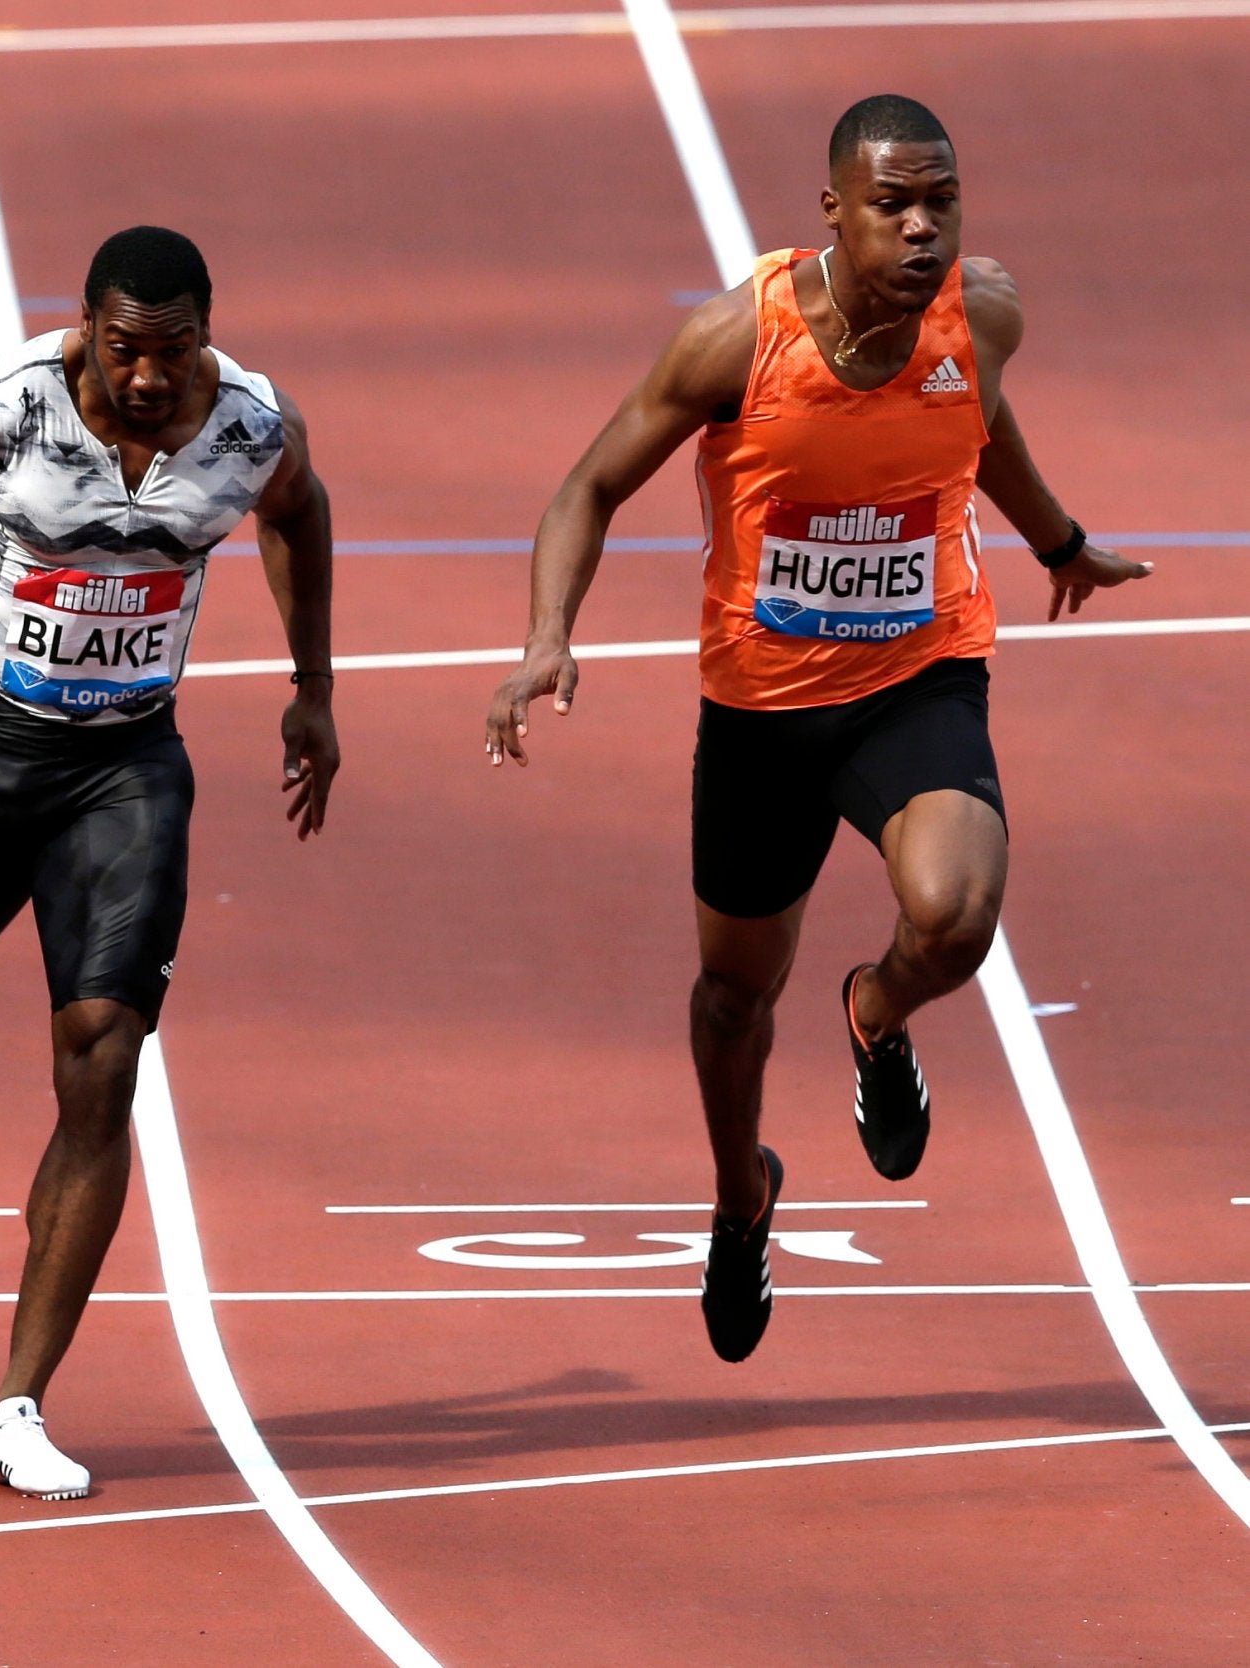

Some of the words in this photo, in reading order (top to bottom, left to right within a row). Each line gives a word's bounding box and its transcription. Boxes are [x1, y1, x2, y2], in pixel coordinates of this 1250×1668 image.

[921, 380, 968, 393] adidas
[210, 440, 261, 455] adidas
[808, 507, 905, 542] müller
[770, 550, 925, 598] HUGHES
[54, 578, 150, 614] müller
[18, 614, 168, 669] BLAKE
[818, 617, 918, 639] London
